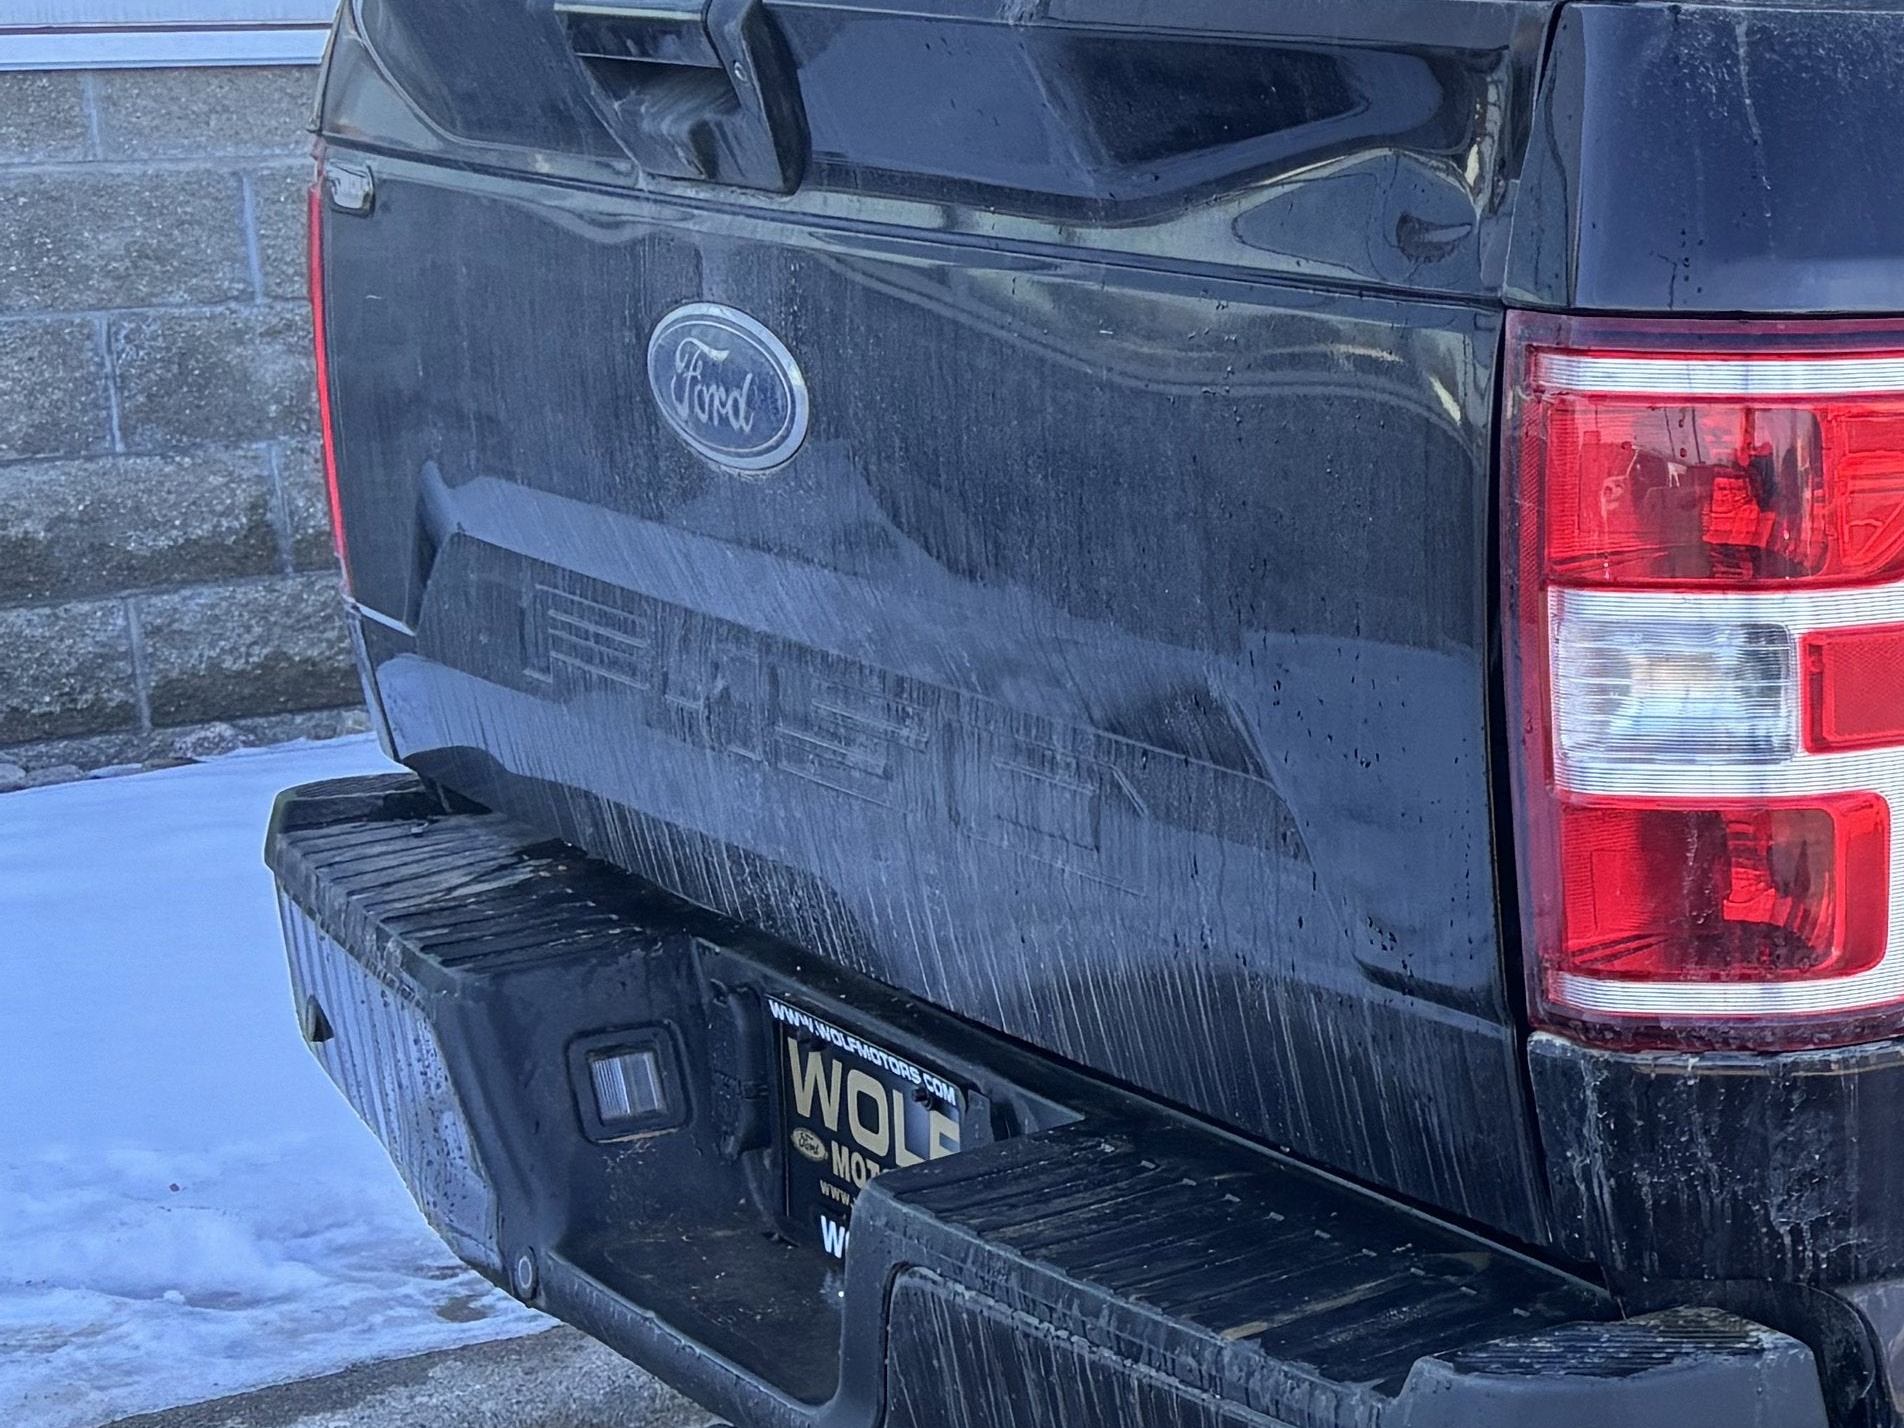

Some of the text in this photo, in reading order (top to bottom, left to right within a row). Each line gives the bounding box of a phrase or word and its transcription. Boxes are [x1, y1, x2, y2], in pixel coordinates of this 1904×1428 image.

[671, 336, 754, 434] Ford
[768, 999, 957, 1106] WWW.WOLFMOTORSCOM
[787, 1036, 961, 1168] WOLF
